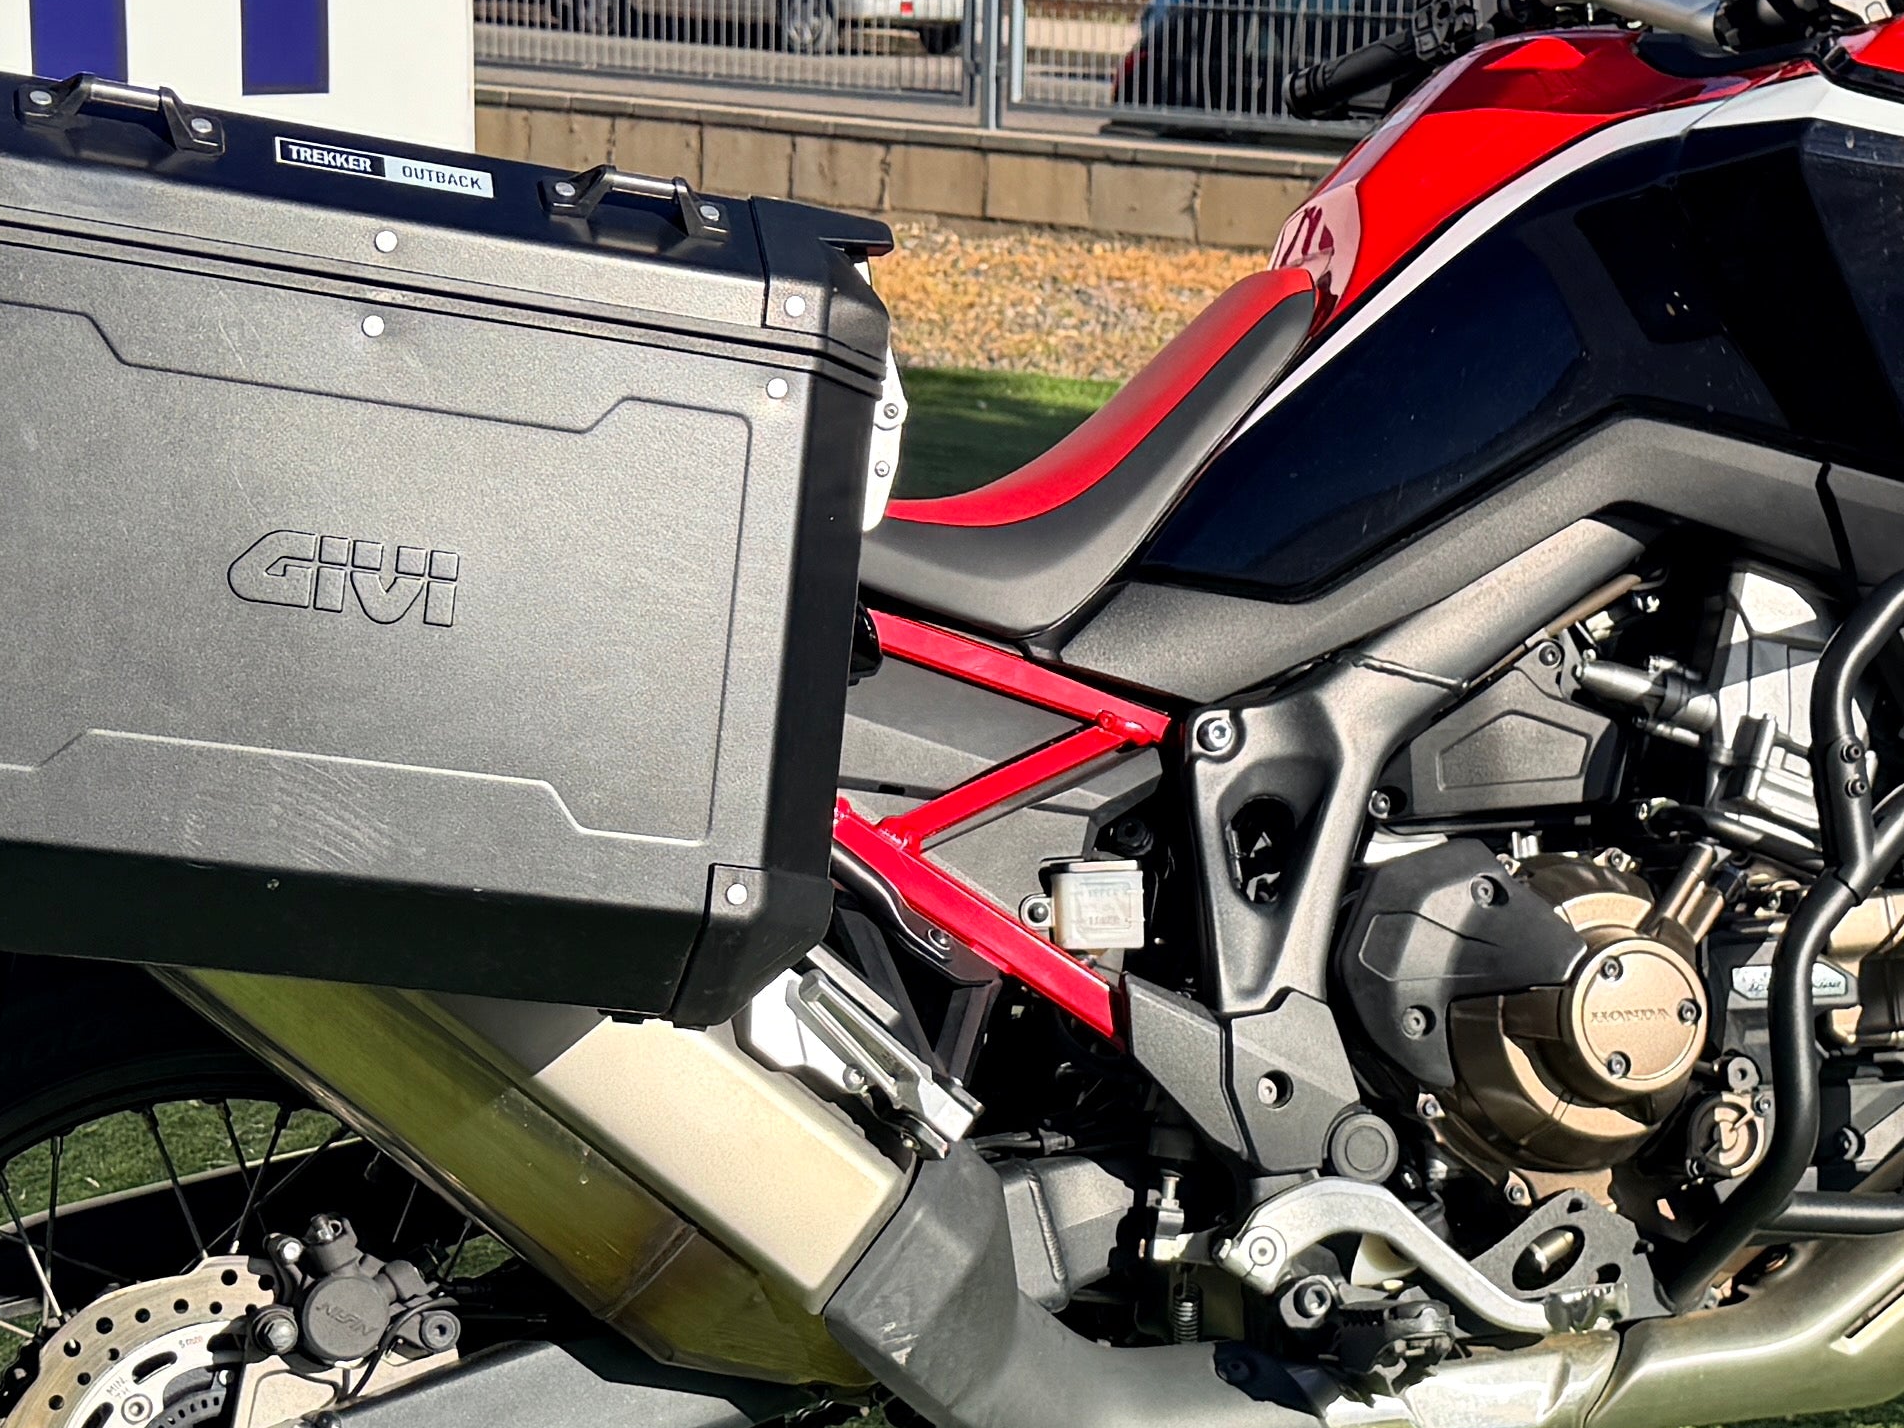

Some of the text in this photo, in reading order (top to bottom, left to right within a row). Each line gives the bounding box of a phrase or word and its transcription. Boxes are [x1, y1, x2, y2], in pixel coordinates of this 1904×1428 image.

[288, 144, 483, 191] TREKKER OUTBACK
[227, 529, 460, 628] GIVI
[1590, 1006, 1673, 1023] HONDA
